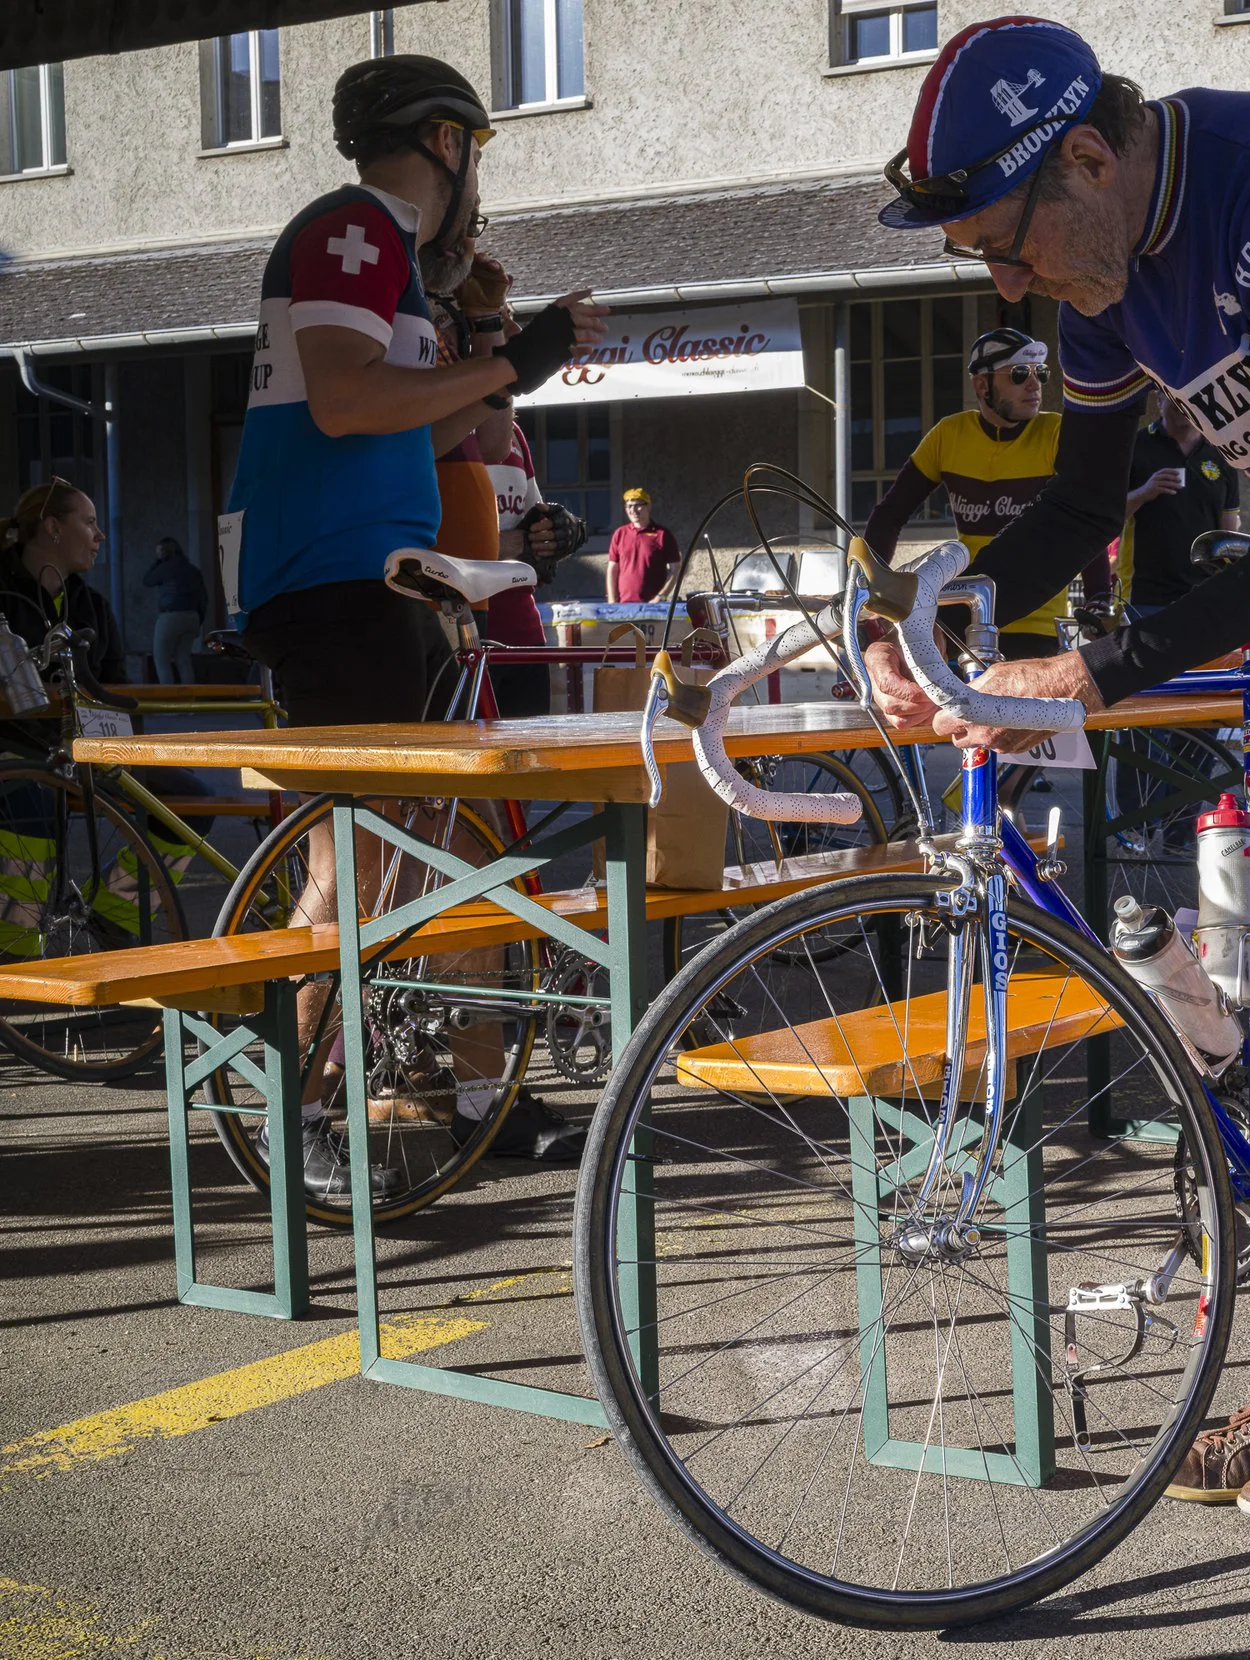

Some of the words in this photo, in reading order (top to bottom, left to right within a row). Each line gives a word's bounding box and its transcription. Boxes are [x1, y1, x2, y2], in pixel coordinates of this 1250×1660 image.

[996, 75, 1090, 178] BROOKLYN
[642, 324, 771, 365] Classic
[250, 364, 273, 391] UP
[992, 912, 1009, 991] GIOS
